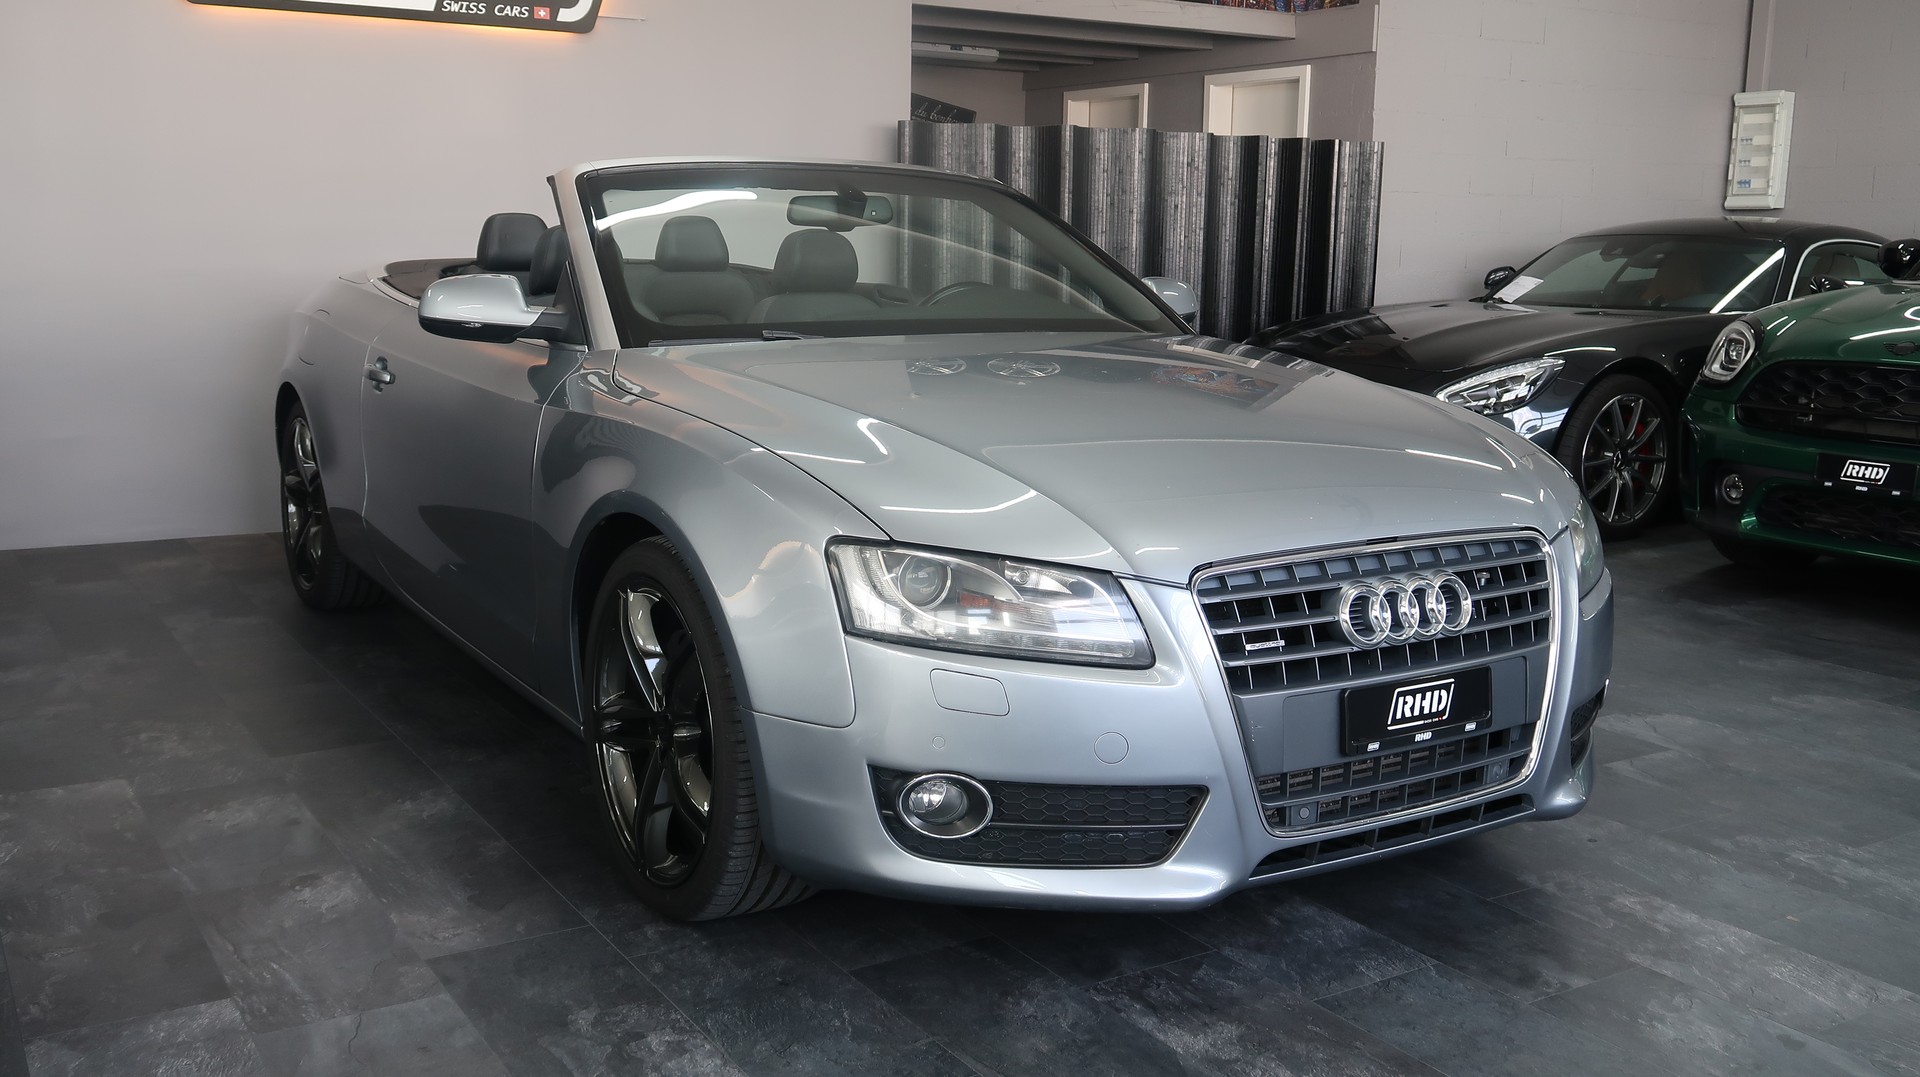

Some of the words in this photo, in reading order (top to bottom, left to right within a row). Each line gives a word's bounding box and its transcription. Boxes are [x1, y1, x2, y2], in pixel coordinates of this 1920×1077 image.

[442, 0, 486, 14] SWISS
[494, 4, 530, 18] CARS
[1846, 464, 1884, 480] RHD
[1396, 689, 1448, 719] RHD
[1415, 731, 1432, 742] RHD
